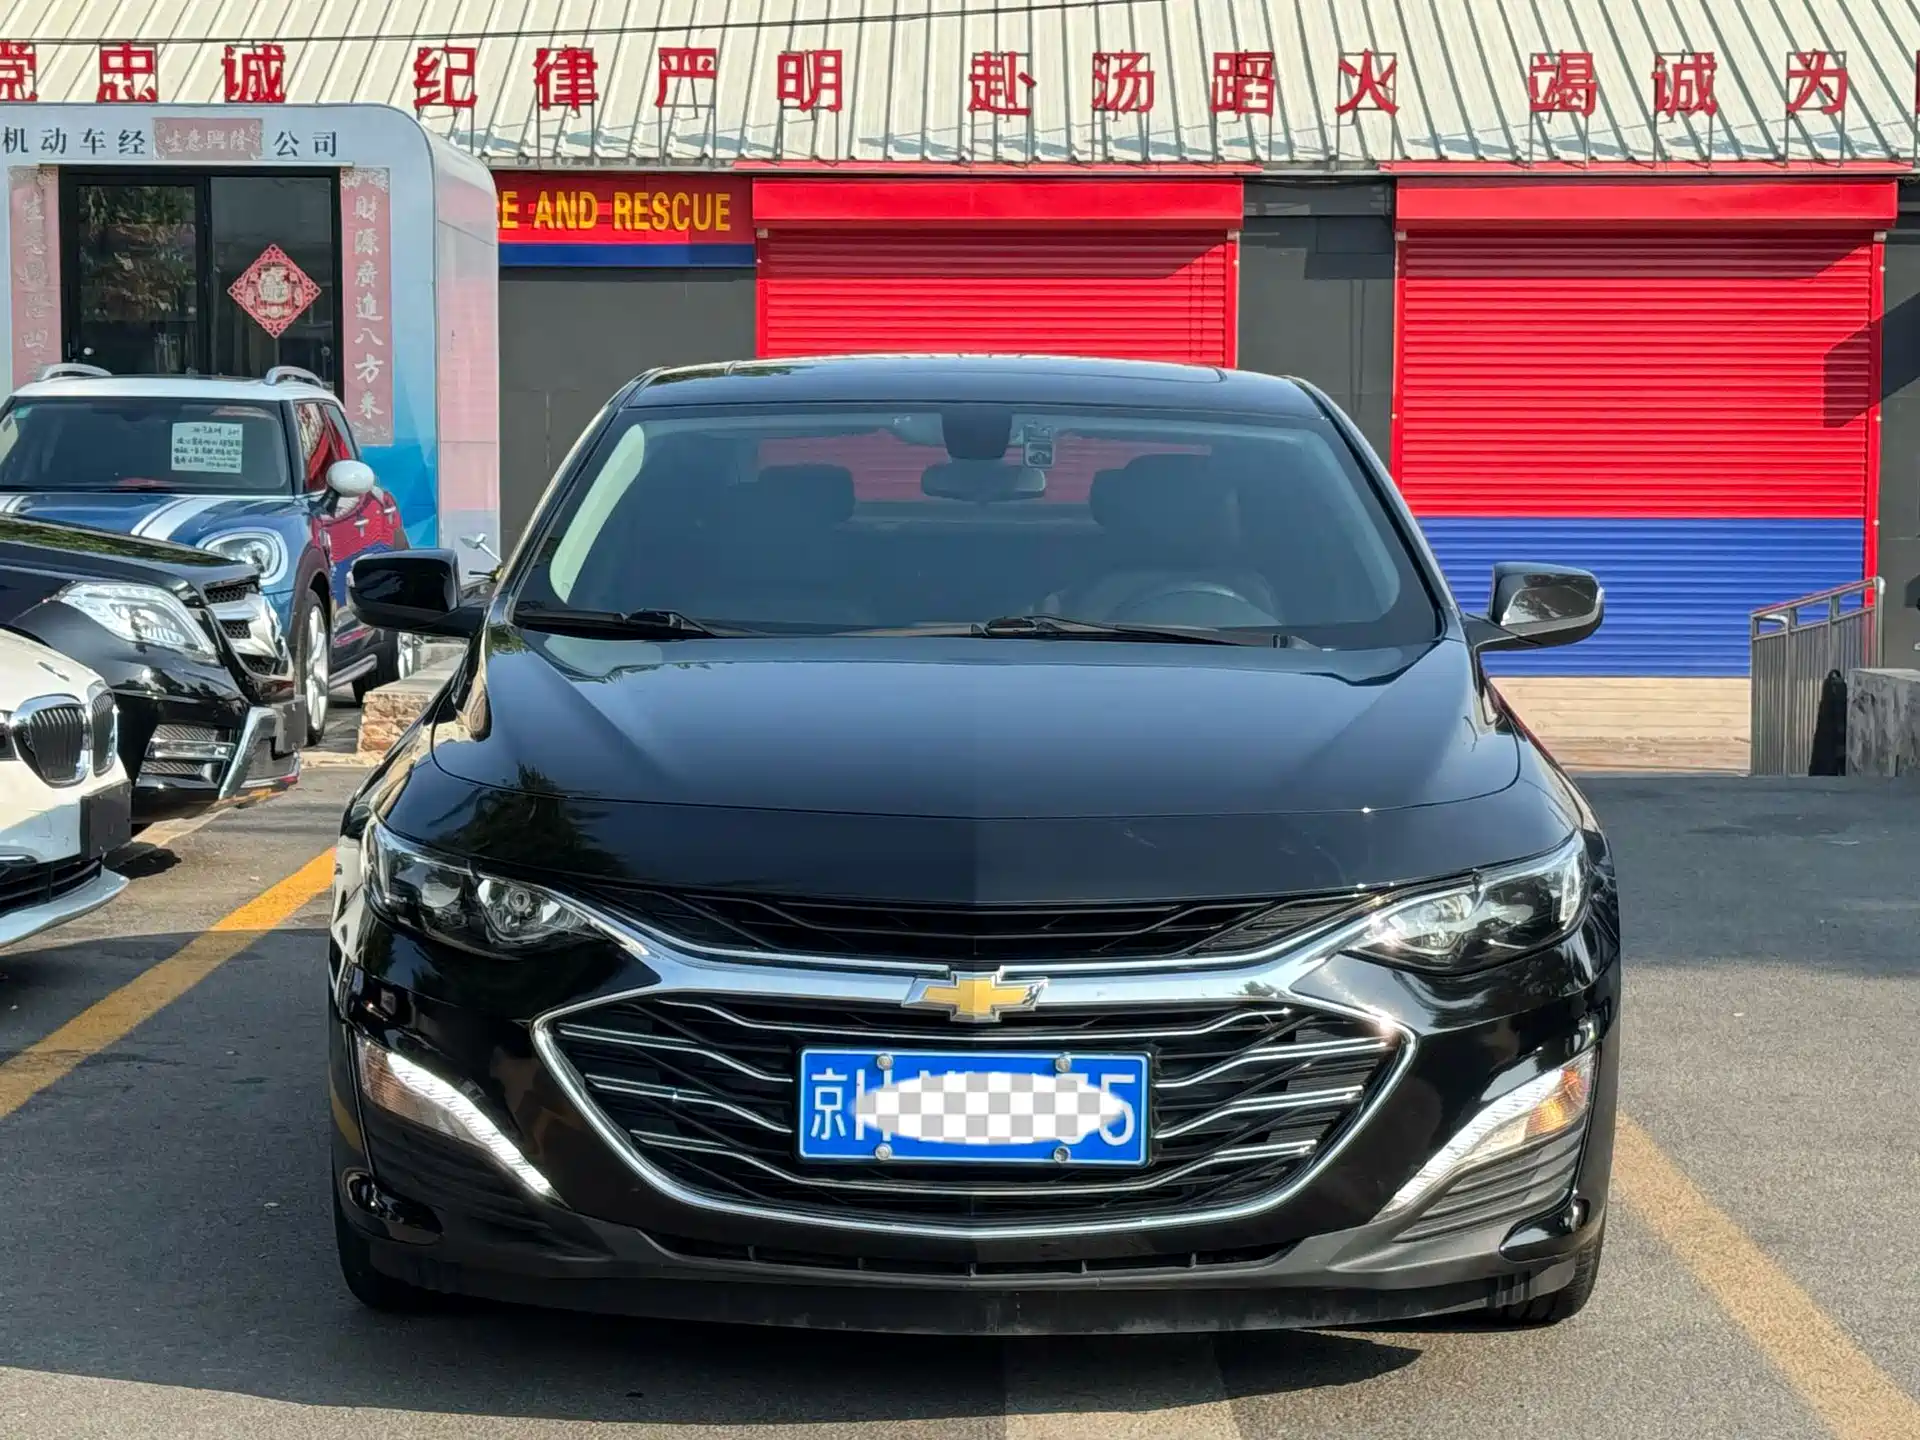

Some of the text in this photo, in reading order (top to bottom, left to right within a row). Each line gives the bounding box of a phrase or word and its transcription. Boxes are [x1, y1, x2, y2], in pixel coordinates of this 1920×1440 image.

[414, 44, 844, 113] 纪律严明
[1529, 49, 1920, 117] 竭诚为
[496, 190, 731, 232] E AND RESCUE
